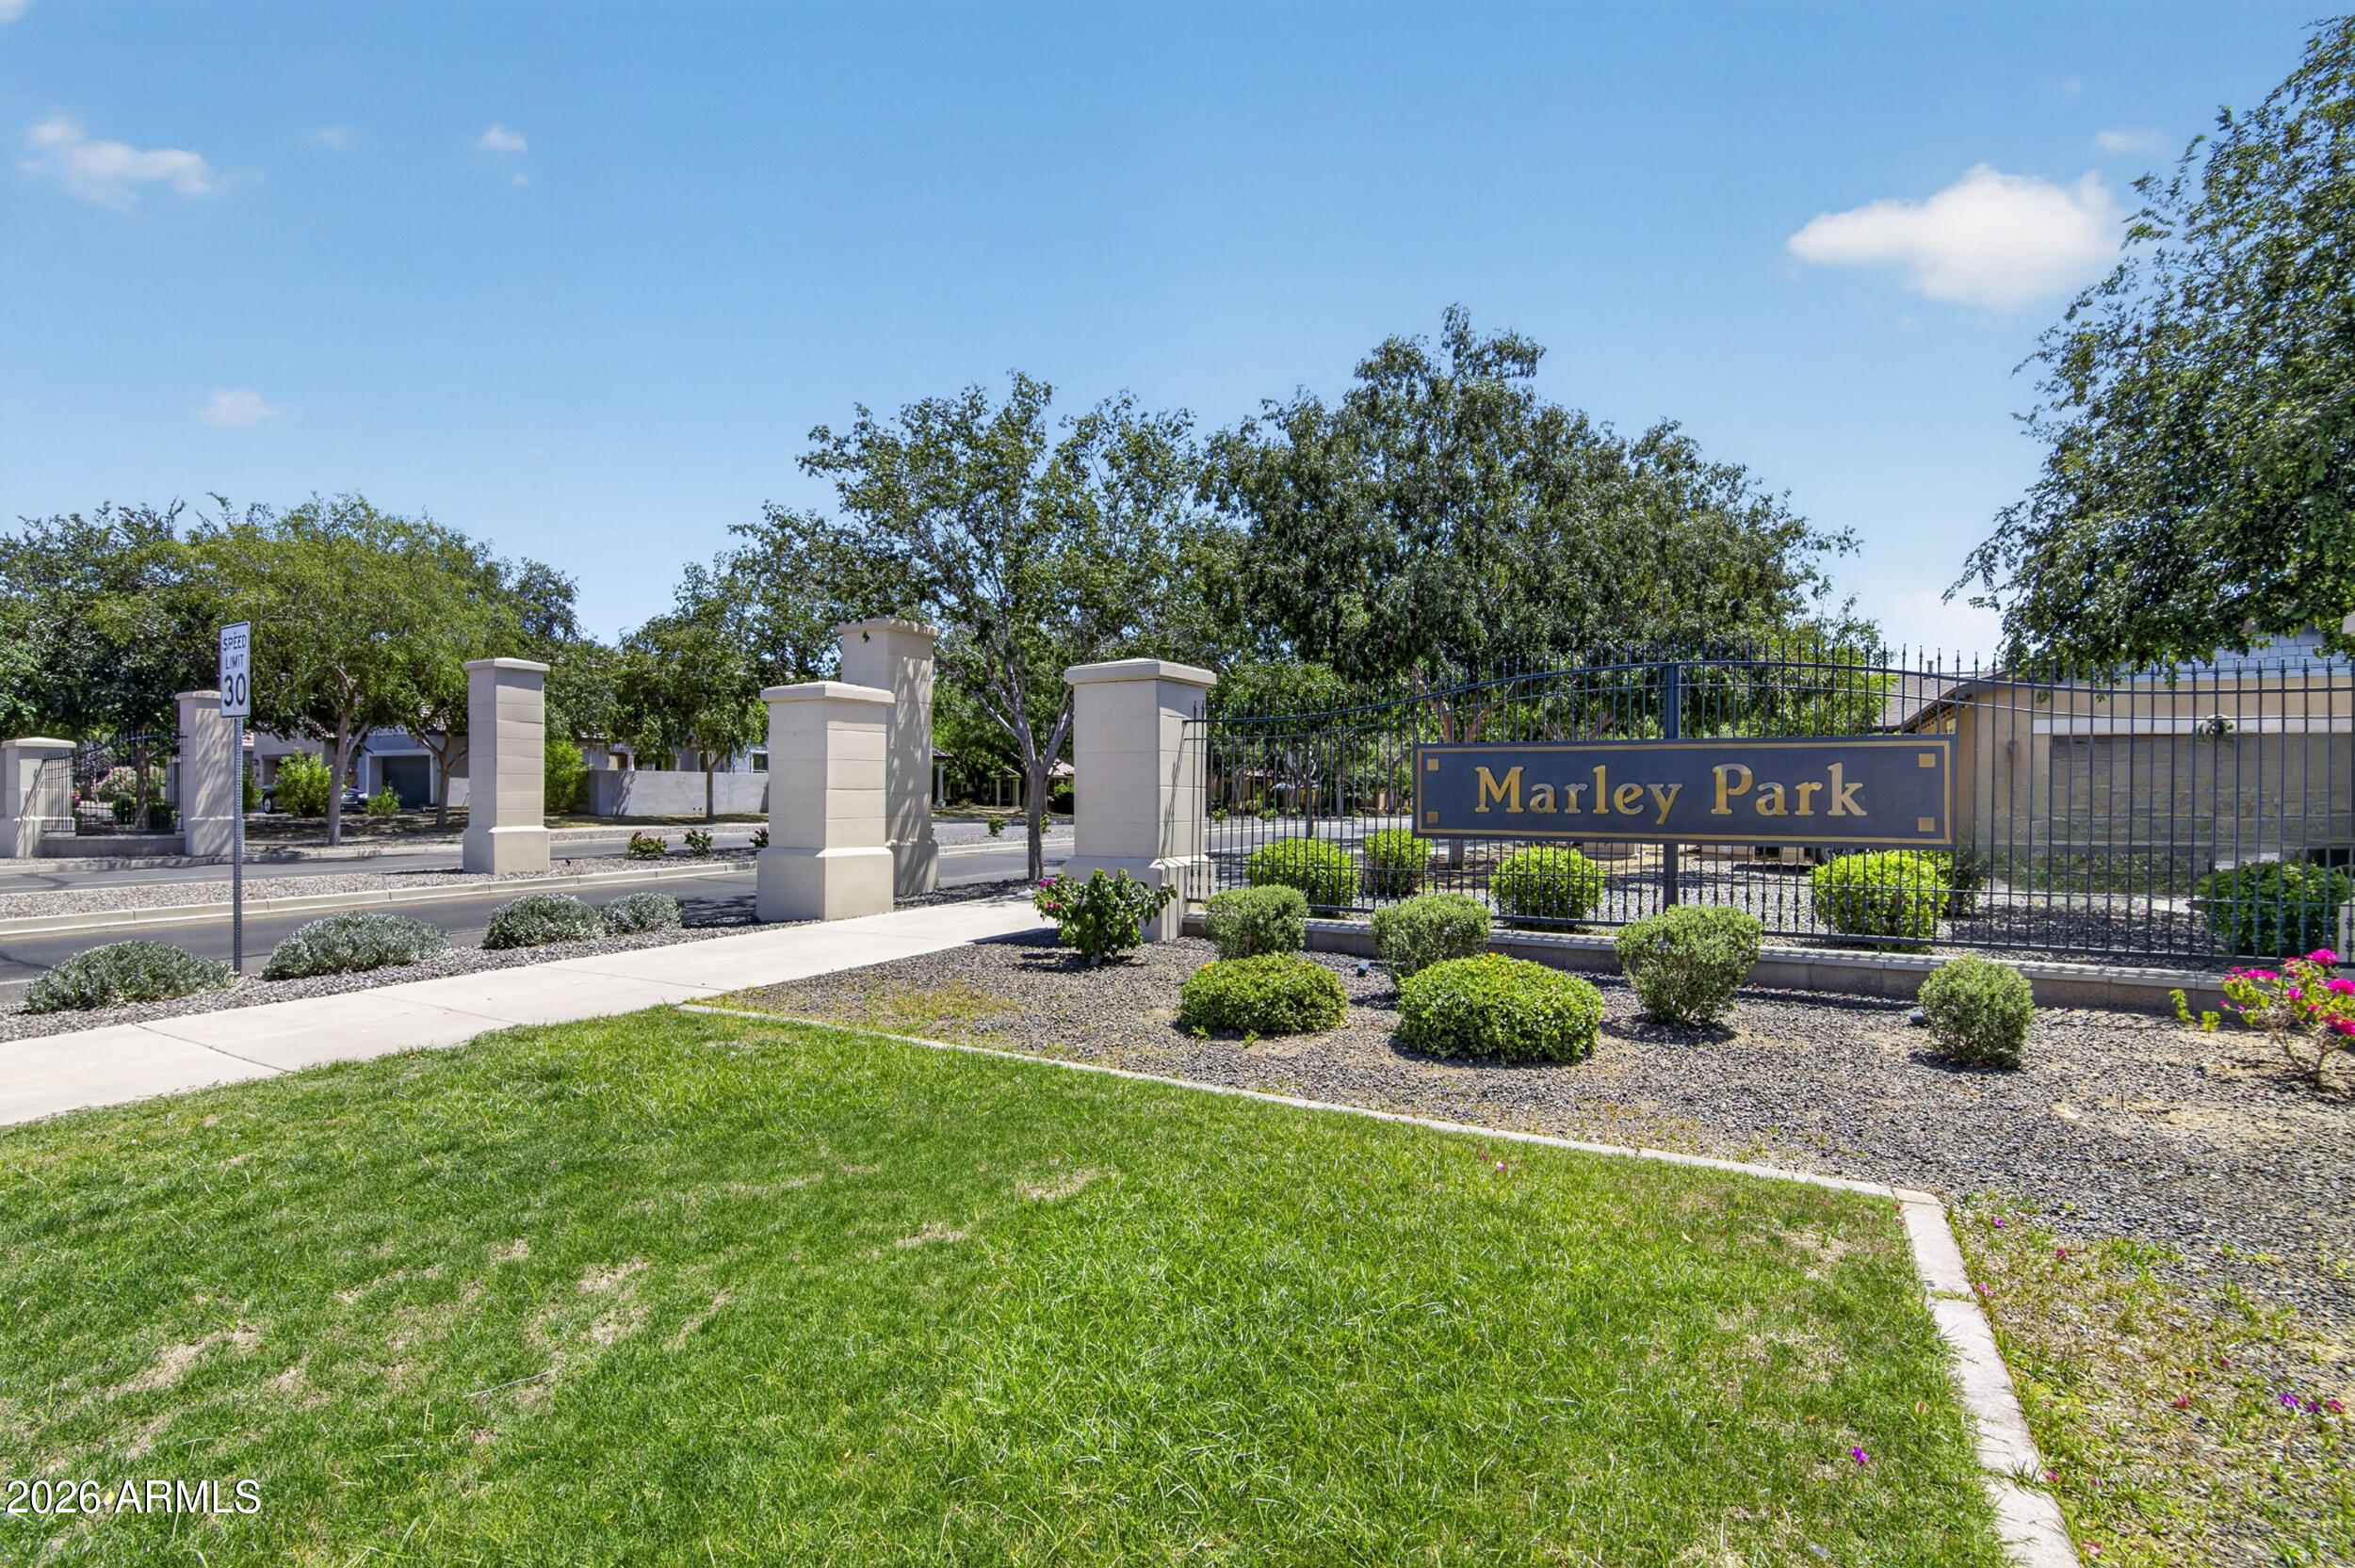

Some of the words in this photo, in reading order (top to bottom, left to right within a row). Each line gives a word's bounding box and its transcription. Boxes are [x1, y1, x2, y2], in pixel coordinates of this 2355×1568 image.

[223, 634, 247, 651] SPEED
[226, 654, 244, 670] LIMIT
[224, 672, 246, 706] 30
[1474, 764, 1682, 824] Marley
[1711, 762, 1867, 816] Park
